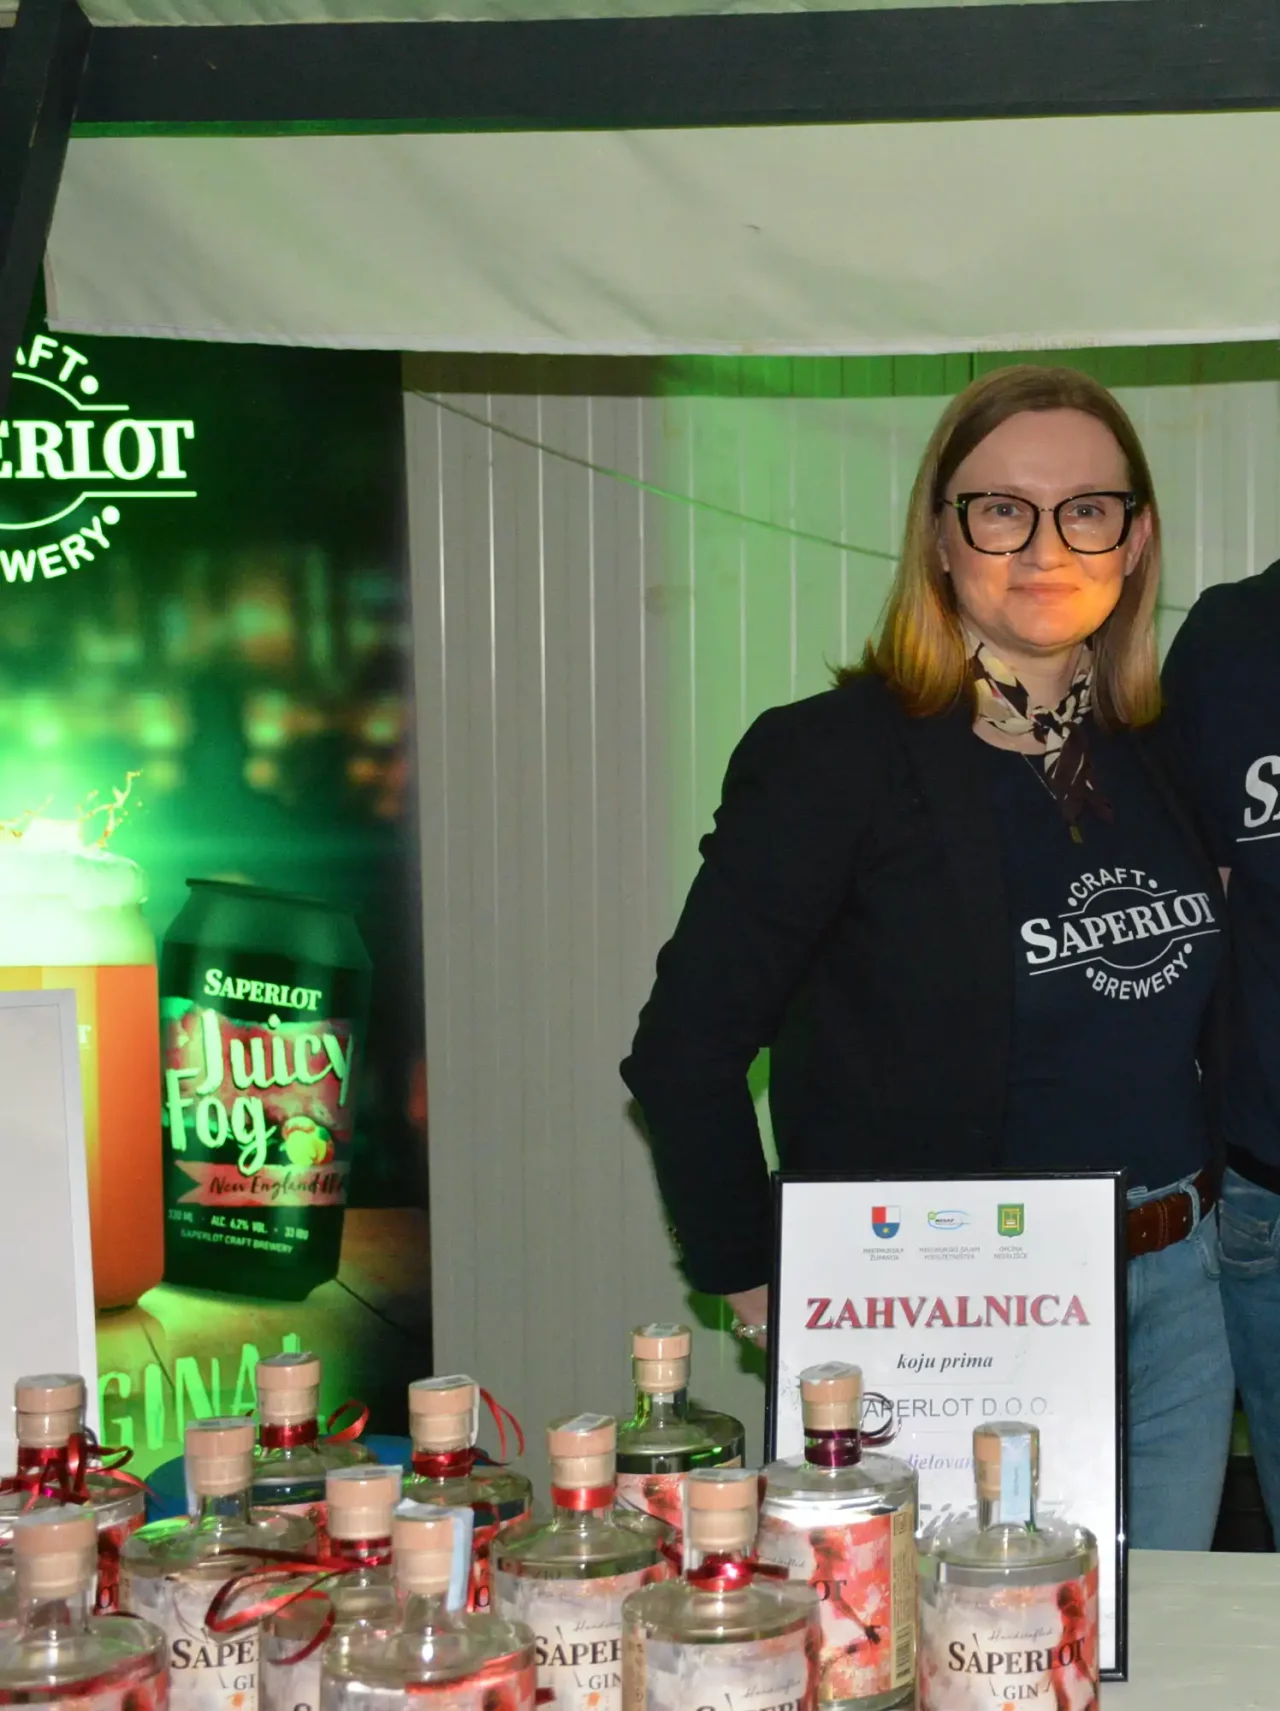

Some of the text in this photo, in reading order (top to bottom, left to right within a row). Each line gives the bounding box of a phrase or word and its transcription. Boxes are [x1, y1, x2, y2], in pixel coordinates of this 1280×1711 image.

[0, 419, 195, 480] RLOT
[0, 516, 111, 583] WERY
[1070, 868, 1146, 898] CRAFT
[1020, 893, 1215, 964] SAPERLOT
[204, 968, 322, 1011] SAPERLOT
[1092, 951, 1188, 1000] BREWERY
[196, 1008, 353, 1106] Juicy
[166, 1068, 276, 1176] Fog
[210, 1176, 244, 1194] New
[250, 1171, 318, 1200] England
[224, 1235, 252, 1247] CRAFT
[253, 1239, 293, 1254] BREWERY
[805, 1294, 1090, 1330] ZAHVALNICA
[897, 1353, 993, 1373] koju prima
[862, 1398, 974, 1418] APERLOT
[172, 1639, 260, 1669] SAPE
[948, 1638, 1085, 1675] SAPERLOT
[233, 1674, 256, 1691] GI
[1003, 1684, 1048, 1700] GIN
